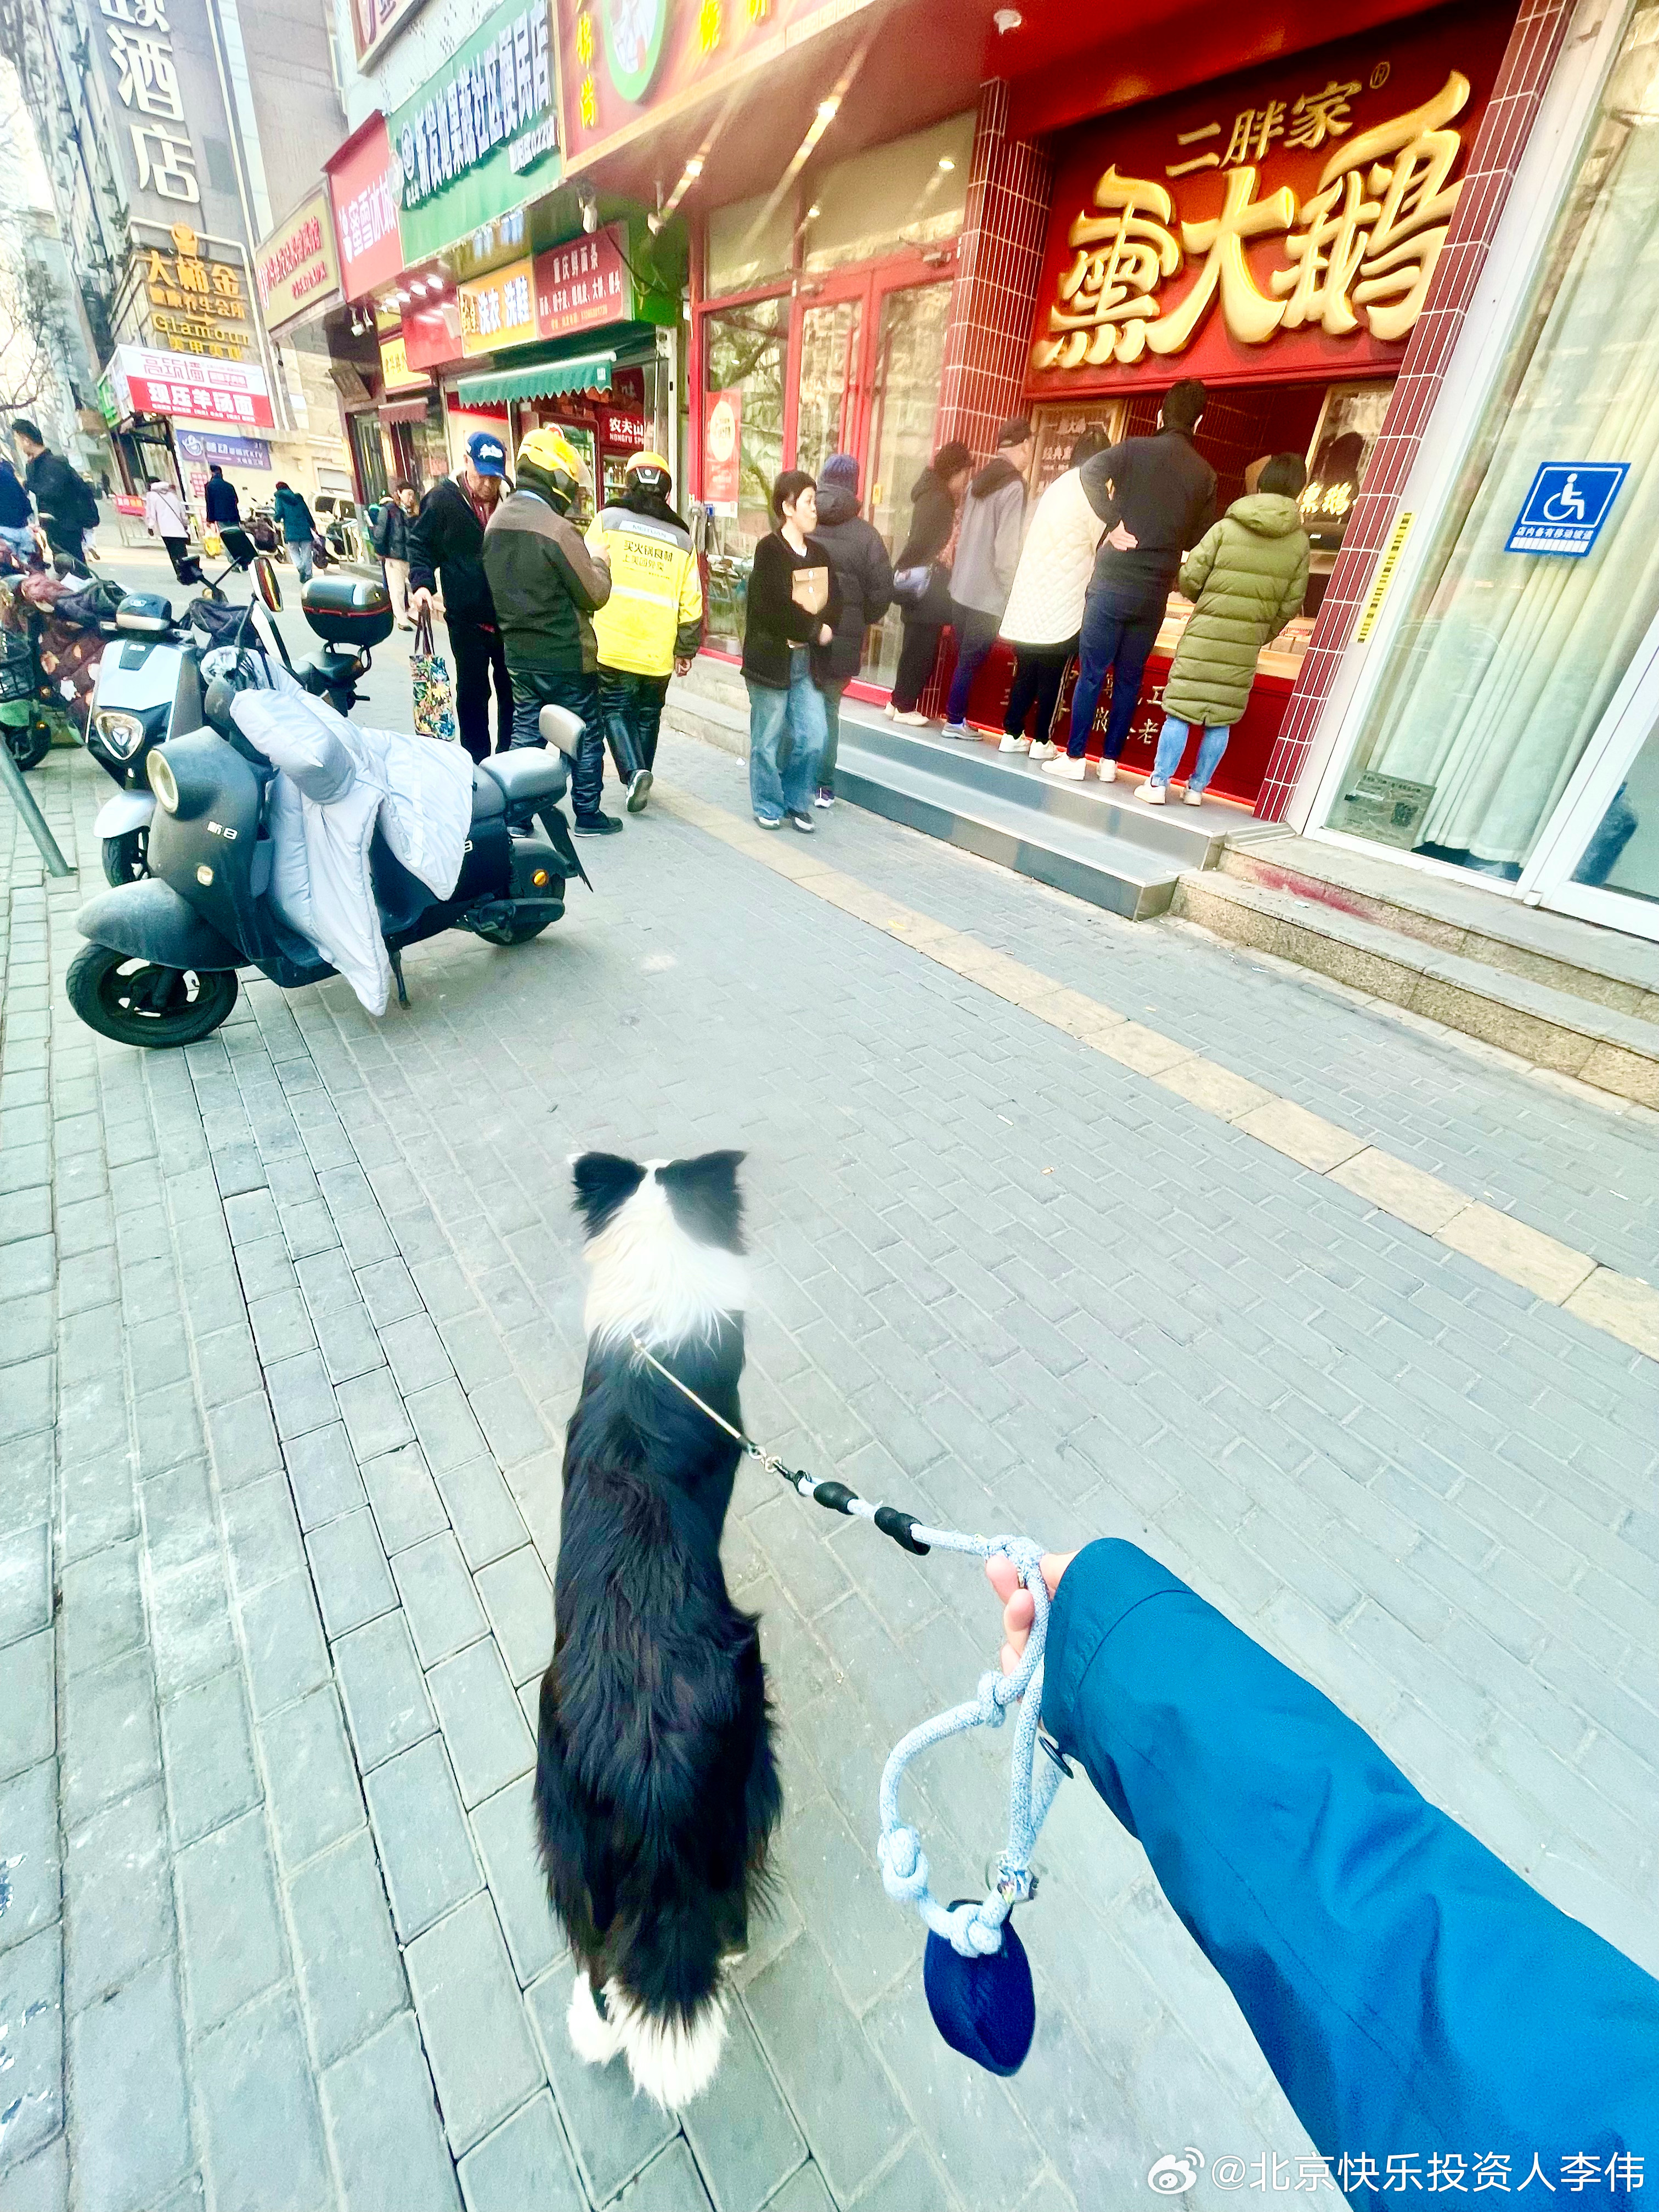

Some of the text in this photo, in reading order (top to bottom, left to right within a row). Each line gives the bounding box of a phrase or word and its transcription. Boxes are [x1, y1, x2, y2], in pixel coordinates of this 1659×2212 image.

[1165, 80, 1362, 177] 二胖家
[478, 288, 501, 335] 洗衣
[504, 275, 530, 328] 洗鞋
[151, 313, 249, 346] Glamour
[610, 416, 645, 437] 农夫山
[633, 524, 667, 538] MEITUAN
[624, 539, 673, 562] 买火锅食材
[623, 554, 664, 572] 上美团外卖
[207, 821, 238, 840] 新日
